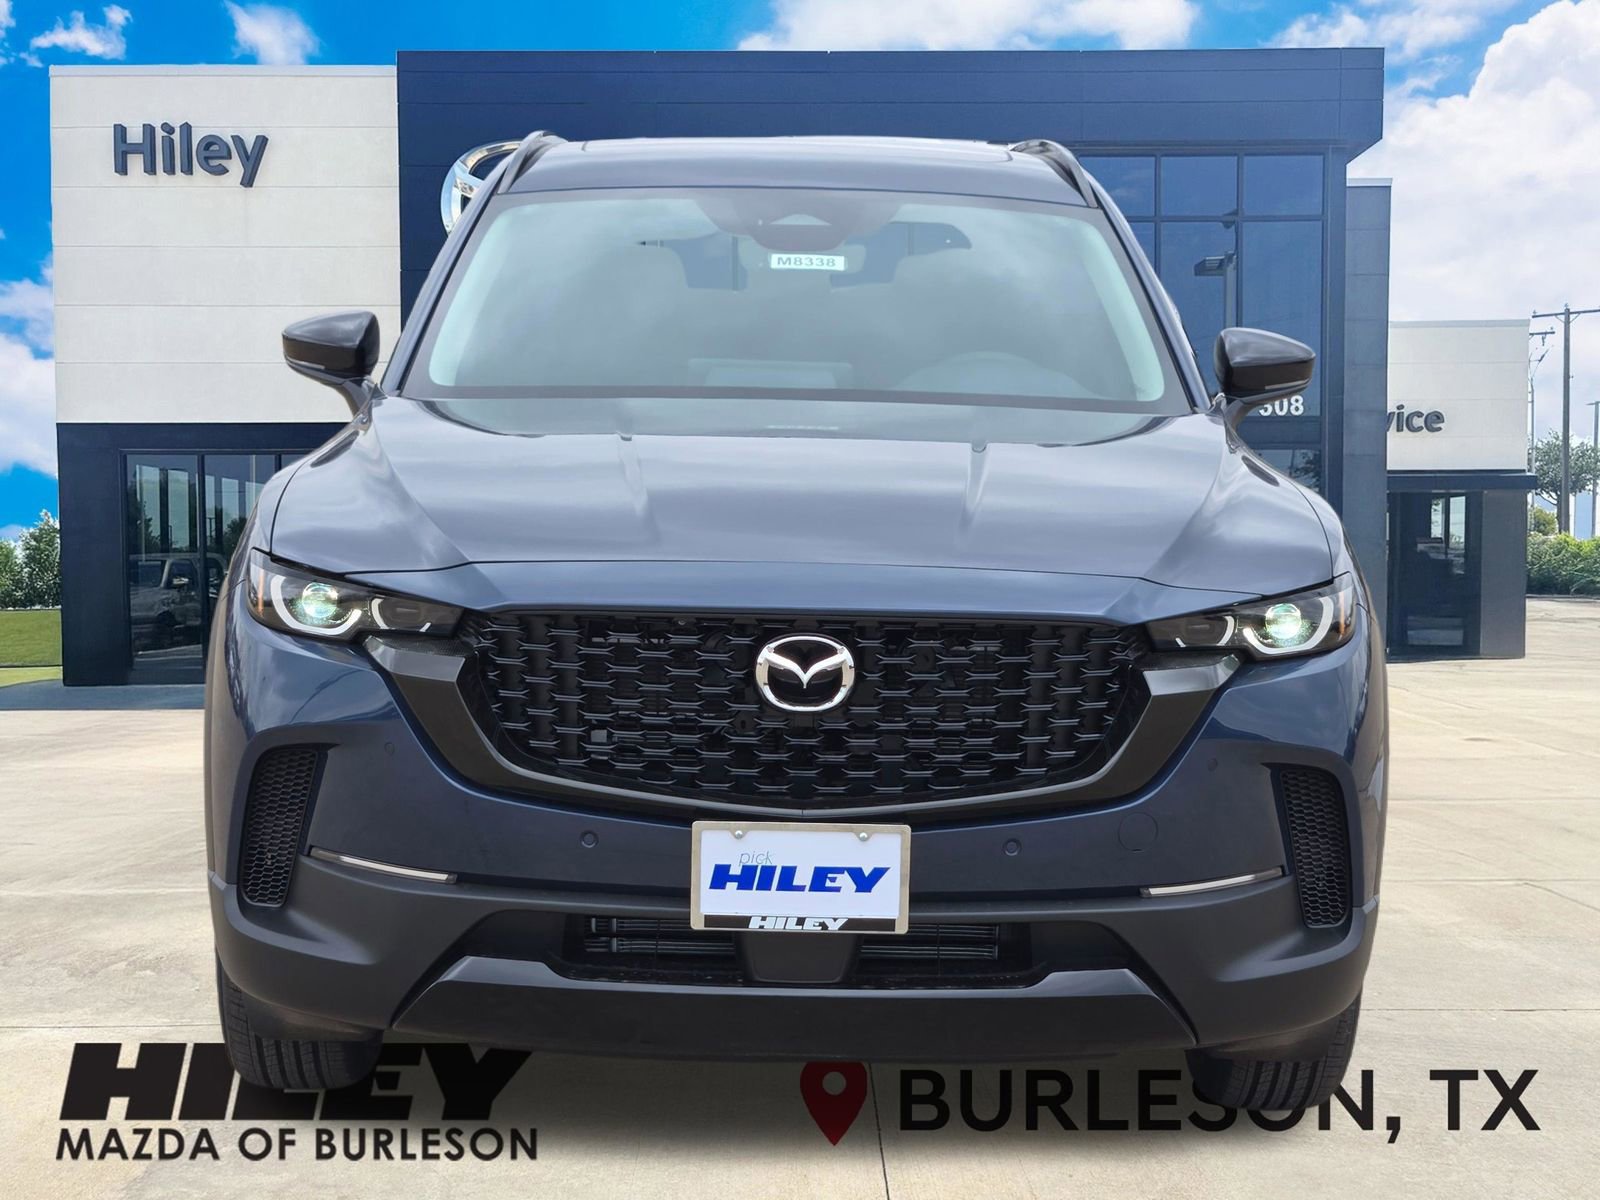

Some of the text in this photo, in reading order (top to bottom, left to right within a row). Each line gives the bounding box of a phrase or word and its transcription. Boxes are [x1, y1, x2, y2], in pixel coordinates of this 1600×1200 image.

[113, 121, 269, 188] Hiley
[777, 256, 836, 268] M8338
[739, 850, 773, 867] pick
[709, 863, 891, 893] HILEY
[748, 915, 848, 931] HILEY
